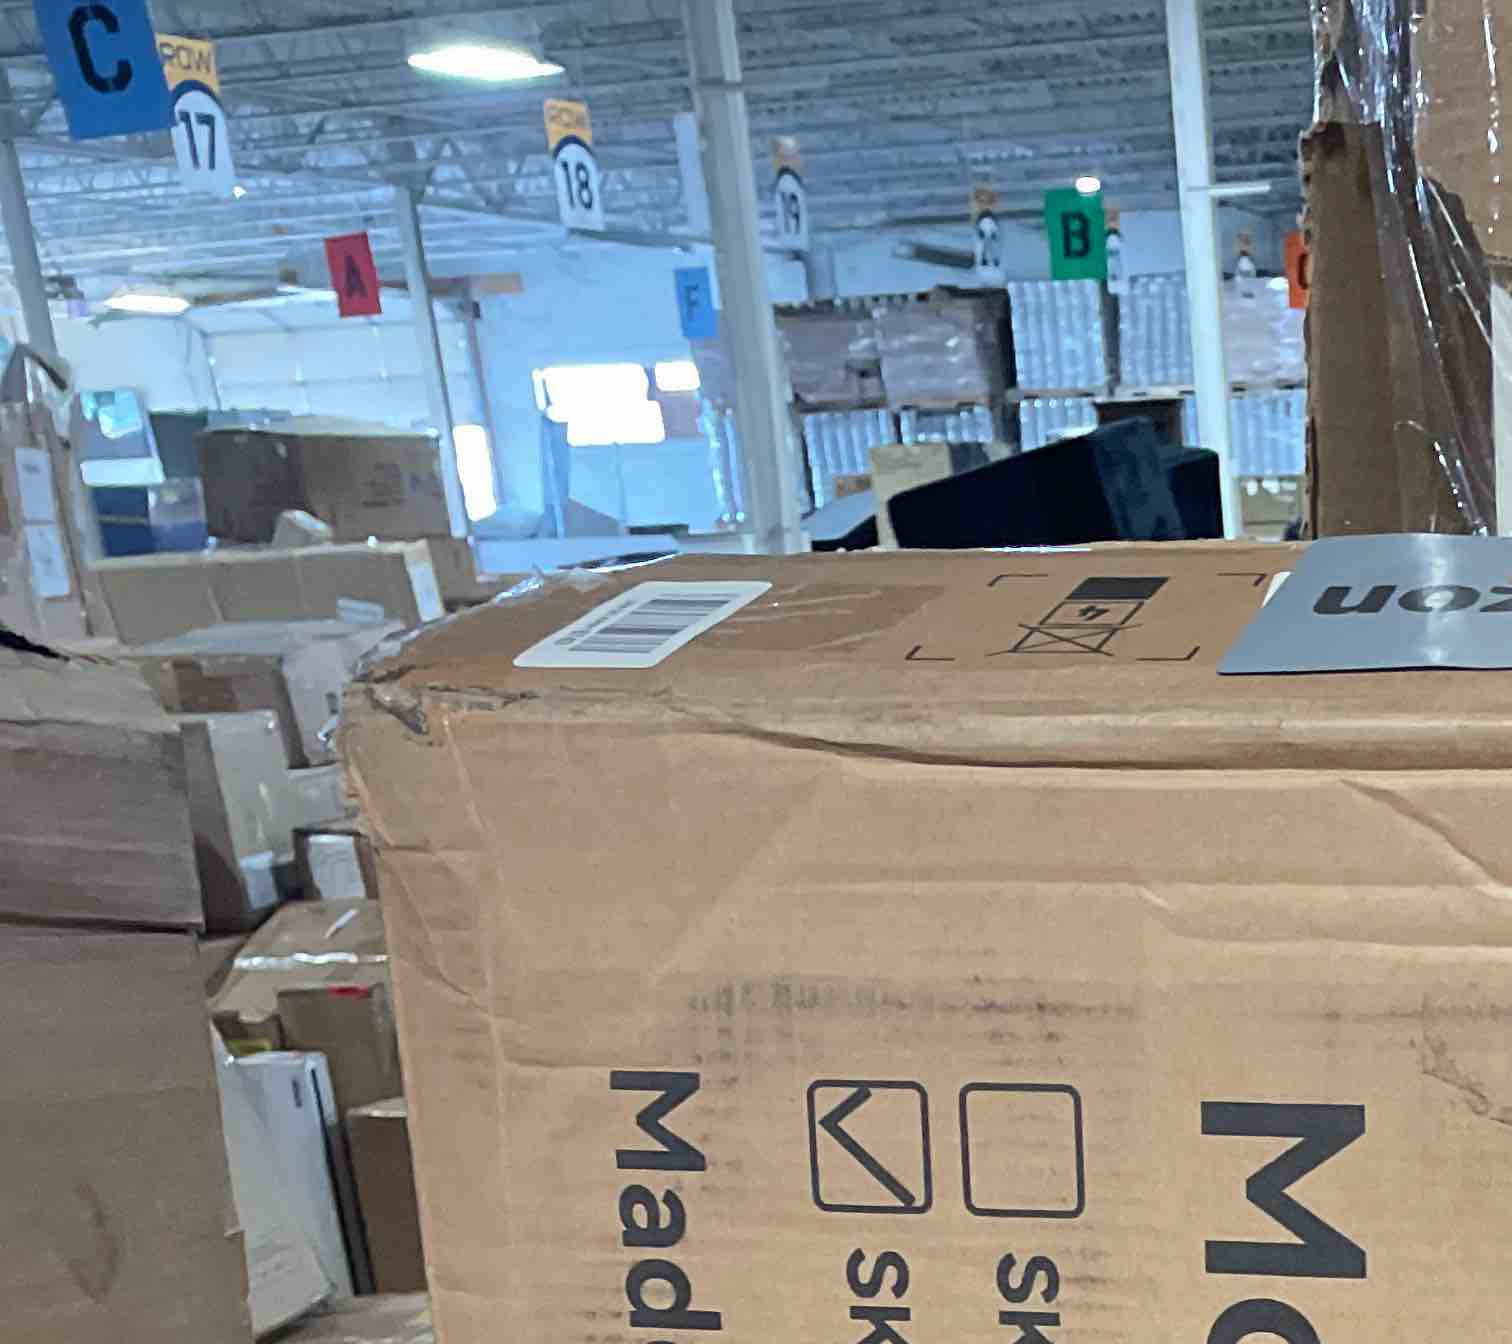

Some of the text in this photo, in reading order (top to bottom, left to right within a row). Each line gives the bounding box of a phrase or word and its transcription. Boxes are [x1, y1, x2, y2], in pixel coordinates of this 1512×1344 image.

[68, 4, 132, 93] C
[179, 111, 216, 170] 17
[561, 160, 593, 209] 18
[1061, 211, 1092, 259] B
